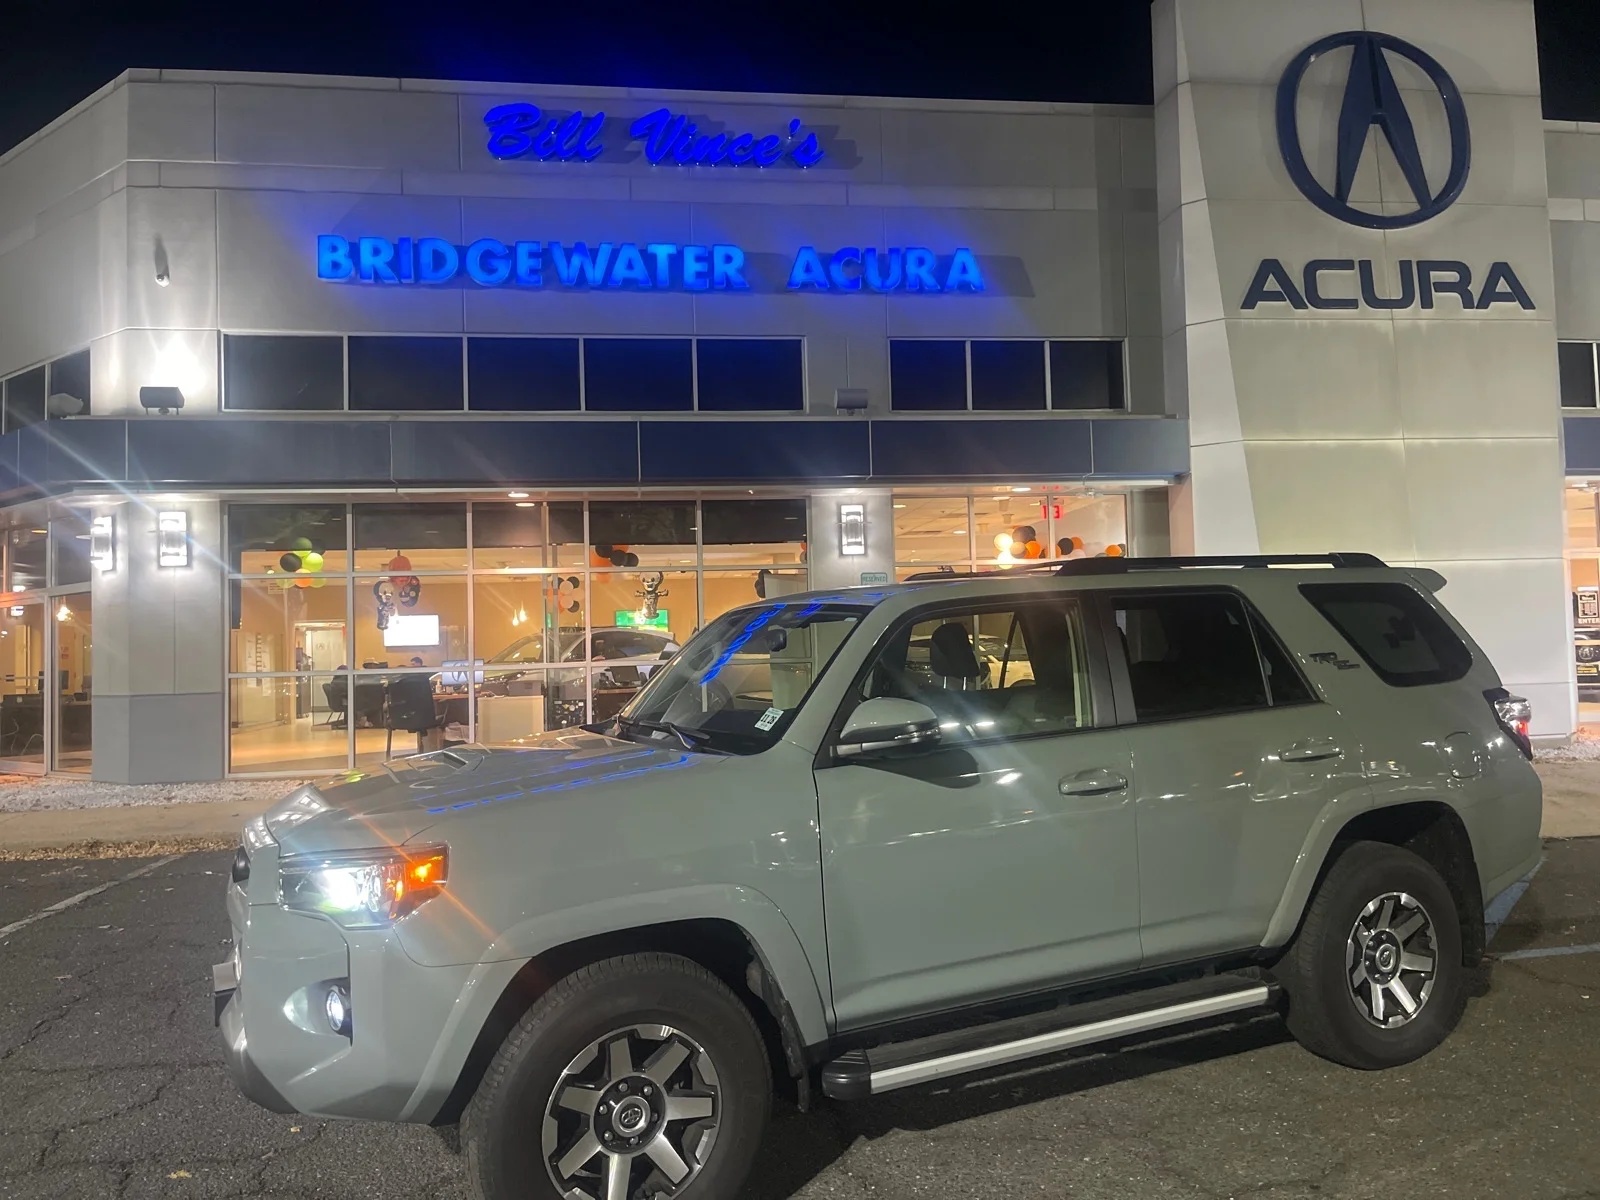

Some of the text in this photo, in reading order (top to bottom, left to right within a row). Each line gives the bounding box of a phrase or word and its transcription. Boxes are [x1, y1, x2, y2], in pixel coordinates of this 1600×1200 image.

[484, 102, 825, 168] Bill Vince's
[316, 234, 986, 292] BRIDGEWATER ACURA
[1240, 258, 1536, 310] ACURA
